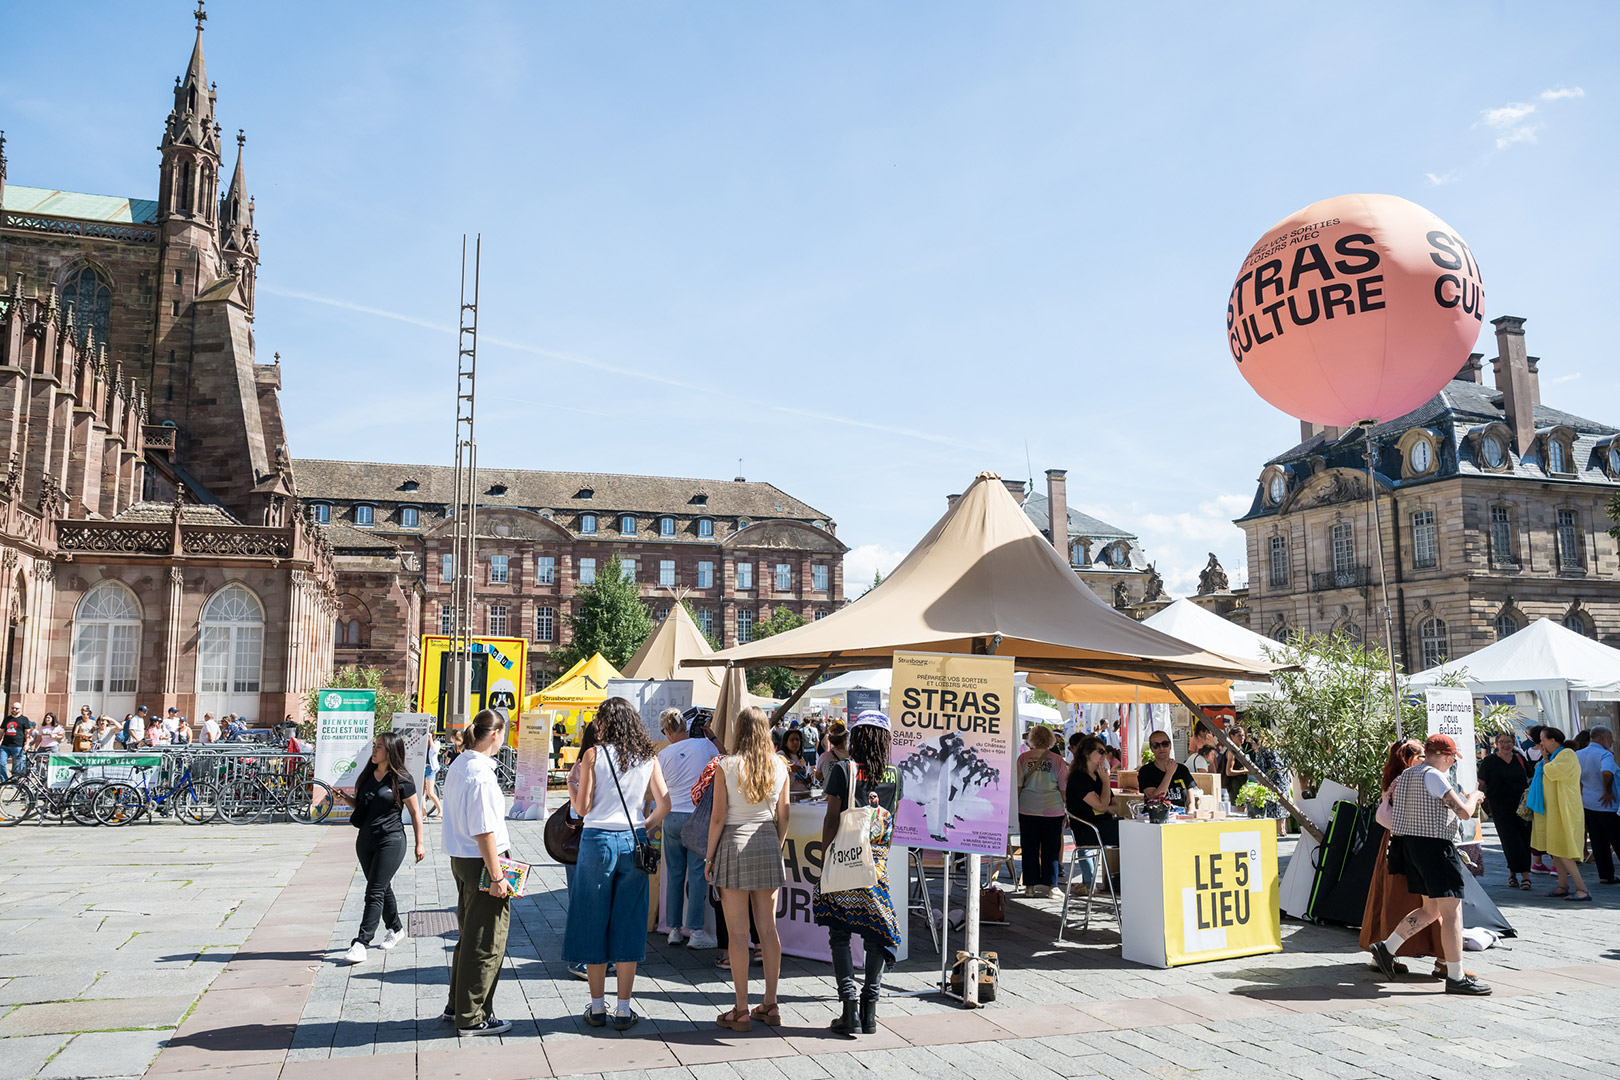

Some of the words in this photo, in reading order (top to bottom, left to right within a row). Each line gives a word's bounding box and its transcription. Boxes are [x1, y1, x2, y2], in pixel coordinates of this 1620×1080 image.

[1270, 233, 1288, 248] VOS
[1289, 218, 1341, 238] SORTIES
[1250, 241, 1288, 266] LOISIRS
[1289, 230, 1321, 247] AVEC
[1425, 230, 1483, 285] ST
[1226, 232, 1381, 331] STRAS
[1434, 273, 1486, 322] CUL
[1229, 274, 1387, 363] CULTURE
[472, 643, 514, 670] IBLIOBUS
[902, 687, 1000, 715] STRAS
[1436, 701, 1472, 713] patrimoine
[321, 726, 338, 734] CECI
[340, 726, 352, 734] EST
[354, 726, 369, 734] UNE
[322, 718, 369, 726] BIENVENUE
[901, 710, 1001, 734] CULTURE
[1439, 724, 1463, 735] éclaire
[1443, 715, 1458, 724] nous
[892, 738, 916, 747] SEPT.
[1027, 761, 1053, 769] STAS
[1195, 853, 1224, 891] LE
[1196, 889, 1250, 930] LIEU
